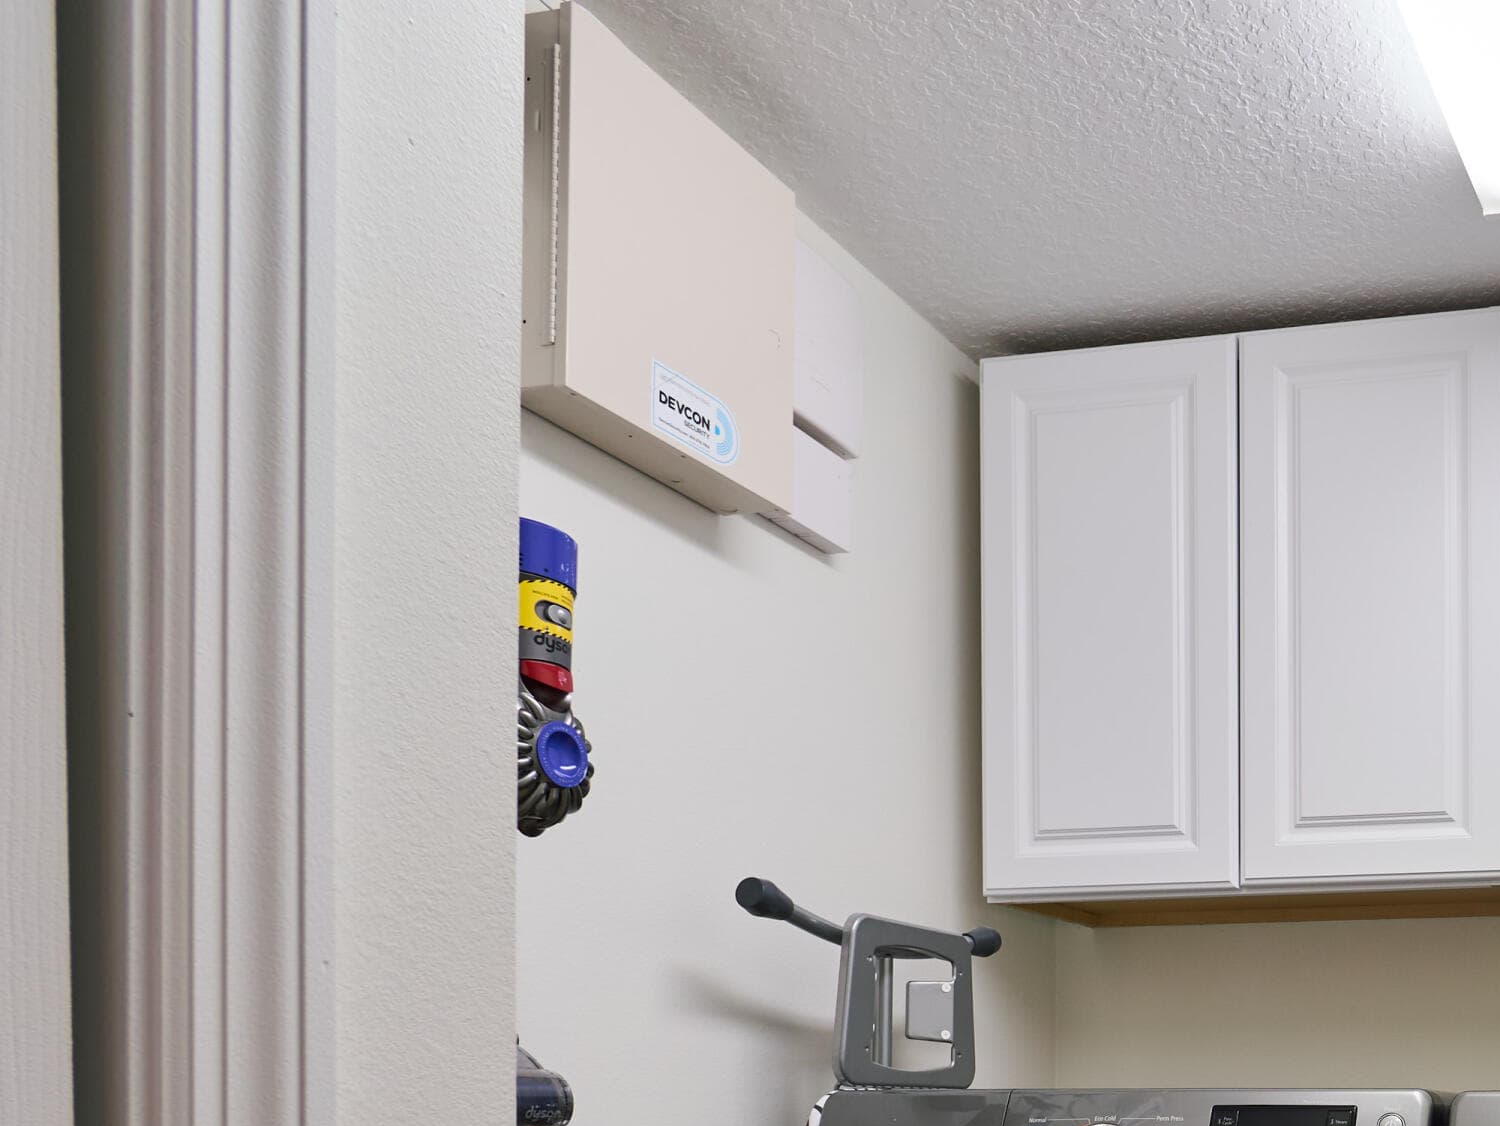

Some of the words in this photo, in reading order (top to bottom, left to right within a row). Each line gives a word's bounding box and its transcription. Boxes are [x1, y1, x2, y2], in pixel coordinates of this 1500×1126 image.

[659, 391, 710, 430] DEVCON
[684, 420, 710, 438] SECURITY
[534, 634, 568, 653] dyso
